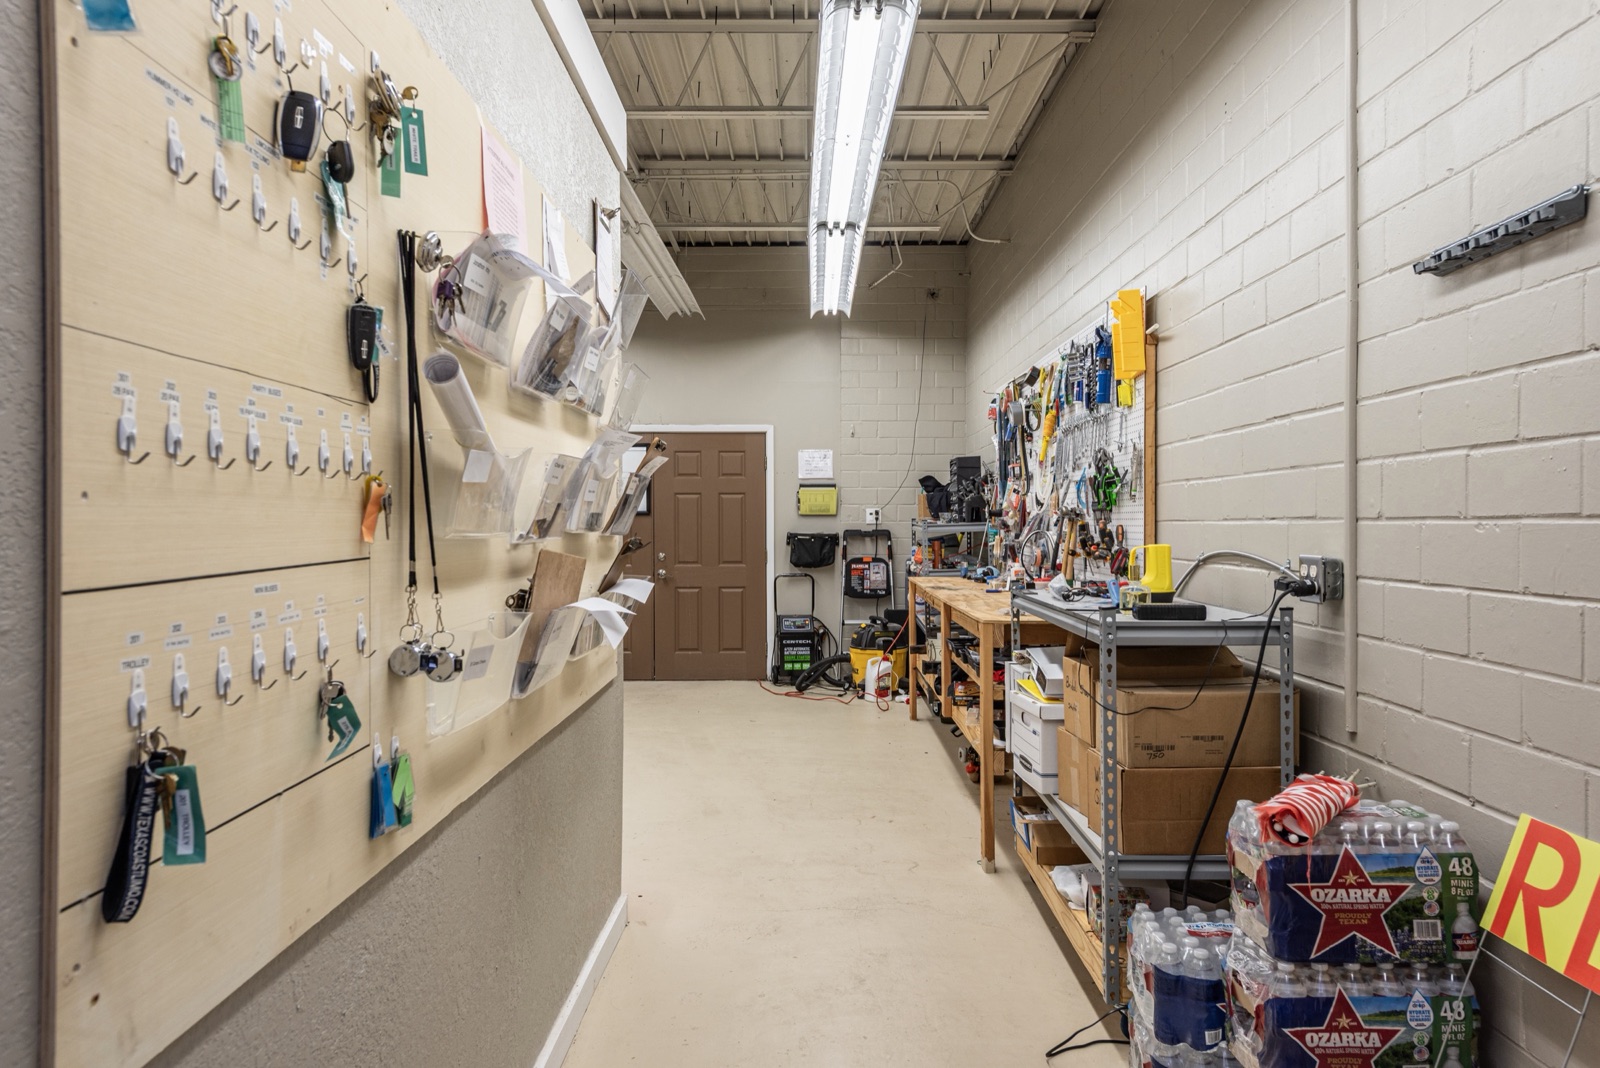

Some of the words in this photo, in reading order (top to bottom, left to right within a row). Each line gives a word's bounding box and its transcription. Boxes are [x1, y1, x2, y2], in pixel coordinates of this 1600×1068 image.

[122, 658, 149, 670] TROLLEY
[1146, 751, 1165, 760] 750
[1448, 857, 1473, 876] 48
[1311, 888, 1391, 903] OZARKA
[1451, 887, 1456, 895] 8
[1440, 1001, 1466, 1020] 48
[1305, 1032, 1382, 1047] OZARKA
